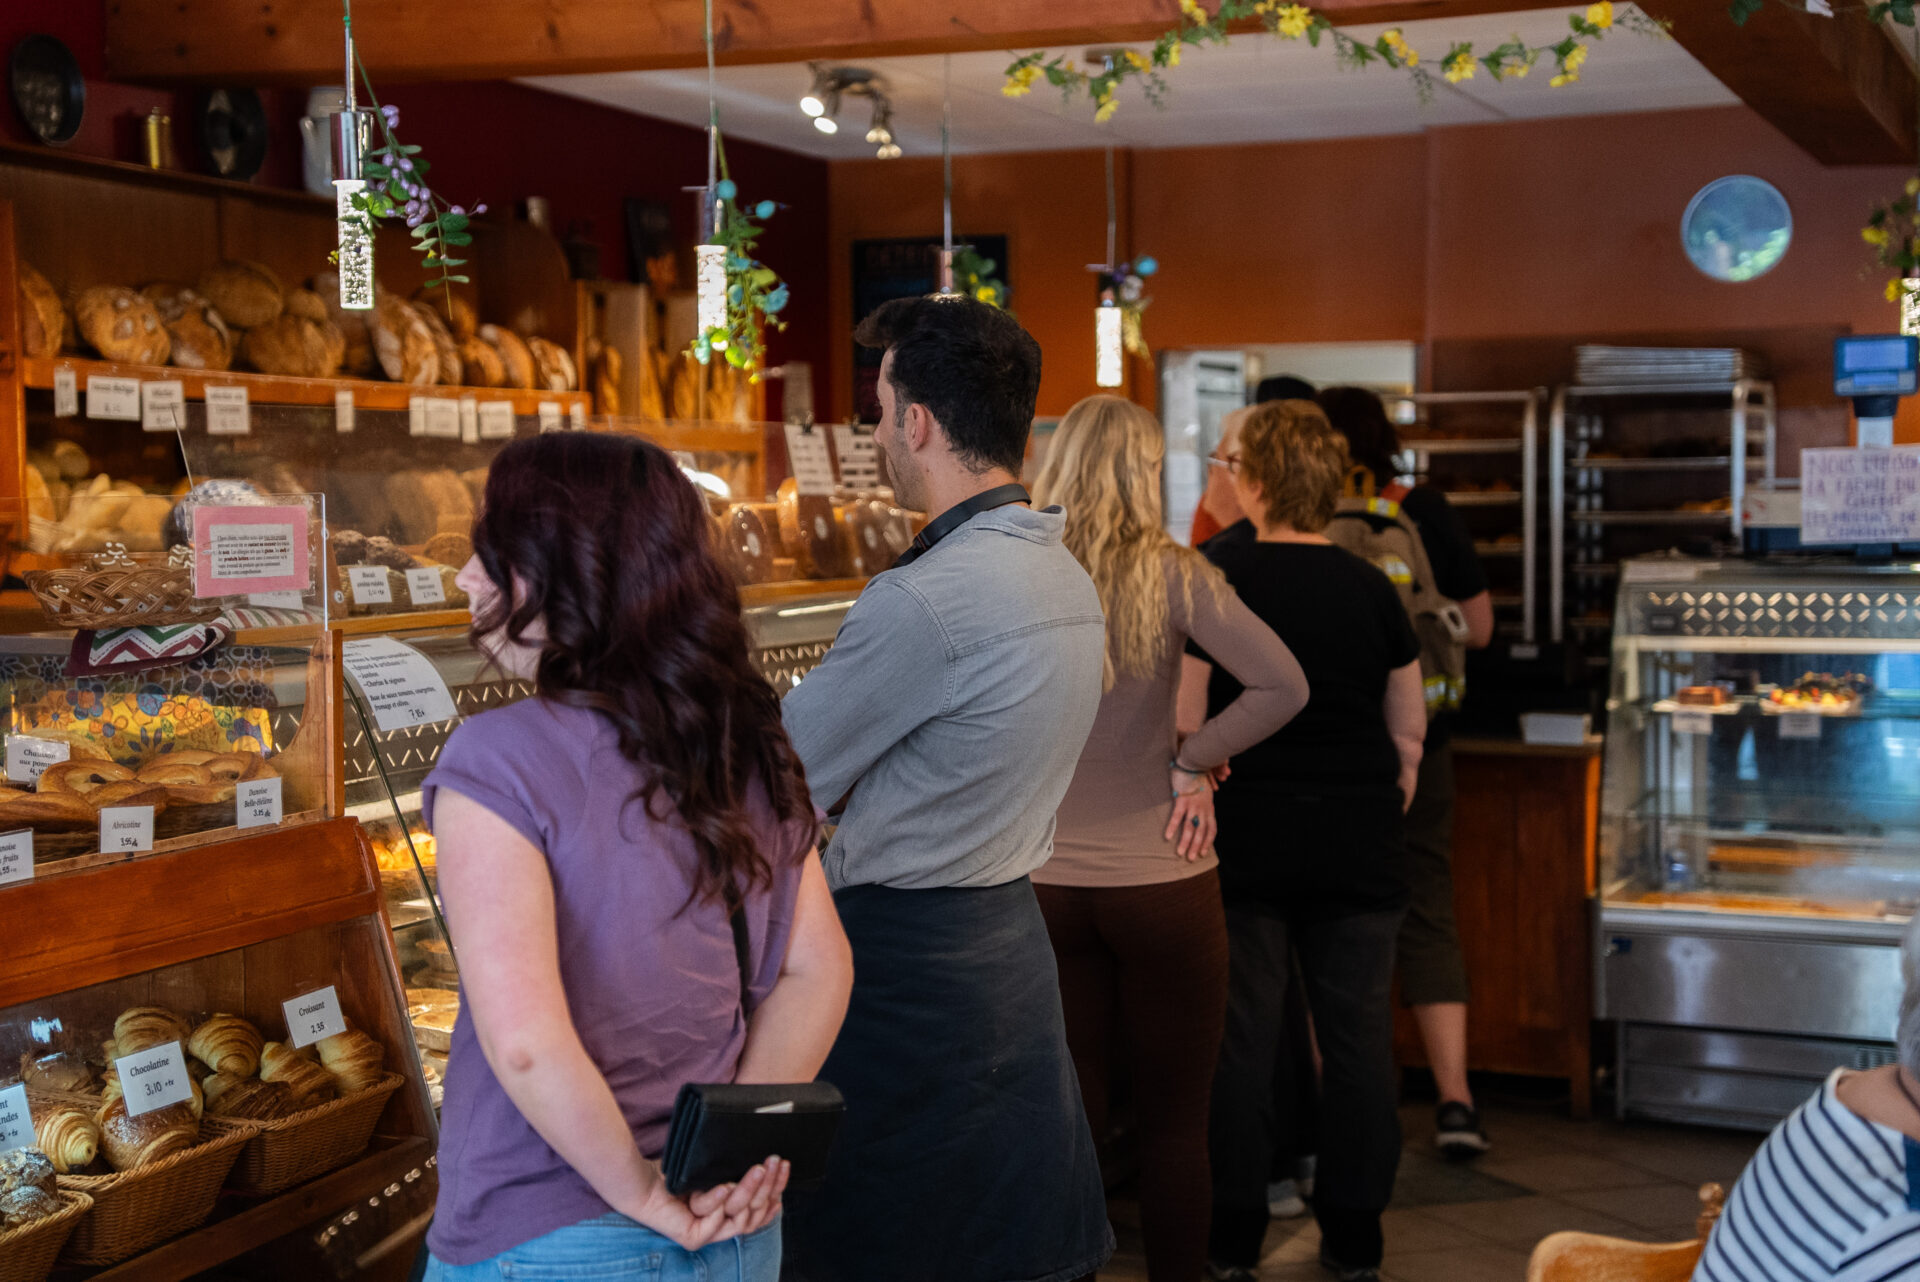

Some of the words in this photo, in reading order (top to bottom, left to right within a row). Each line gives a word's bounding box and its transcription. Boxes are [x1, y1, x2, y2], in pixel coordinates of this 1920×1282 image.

[23, 749, 56, 760] Chausson
[112, 820, 141, 830] Abricotine
[298, 1001, 325, 1017] Croissant
[129, 1057, 170, 1077] Chocolatine
